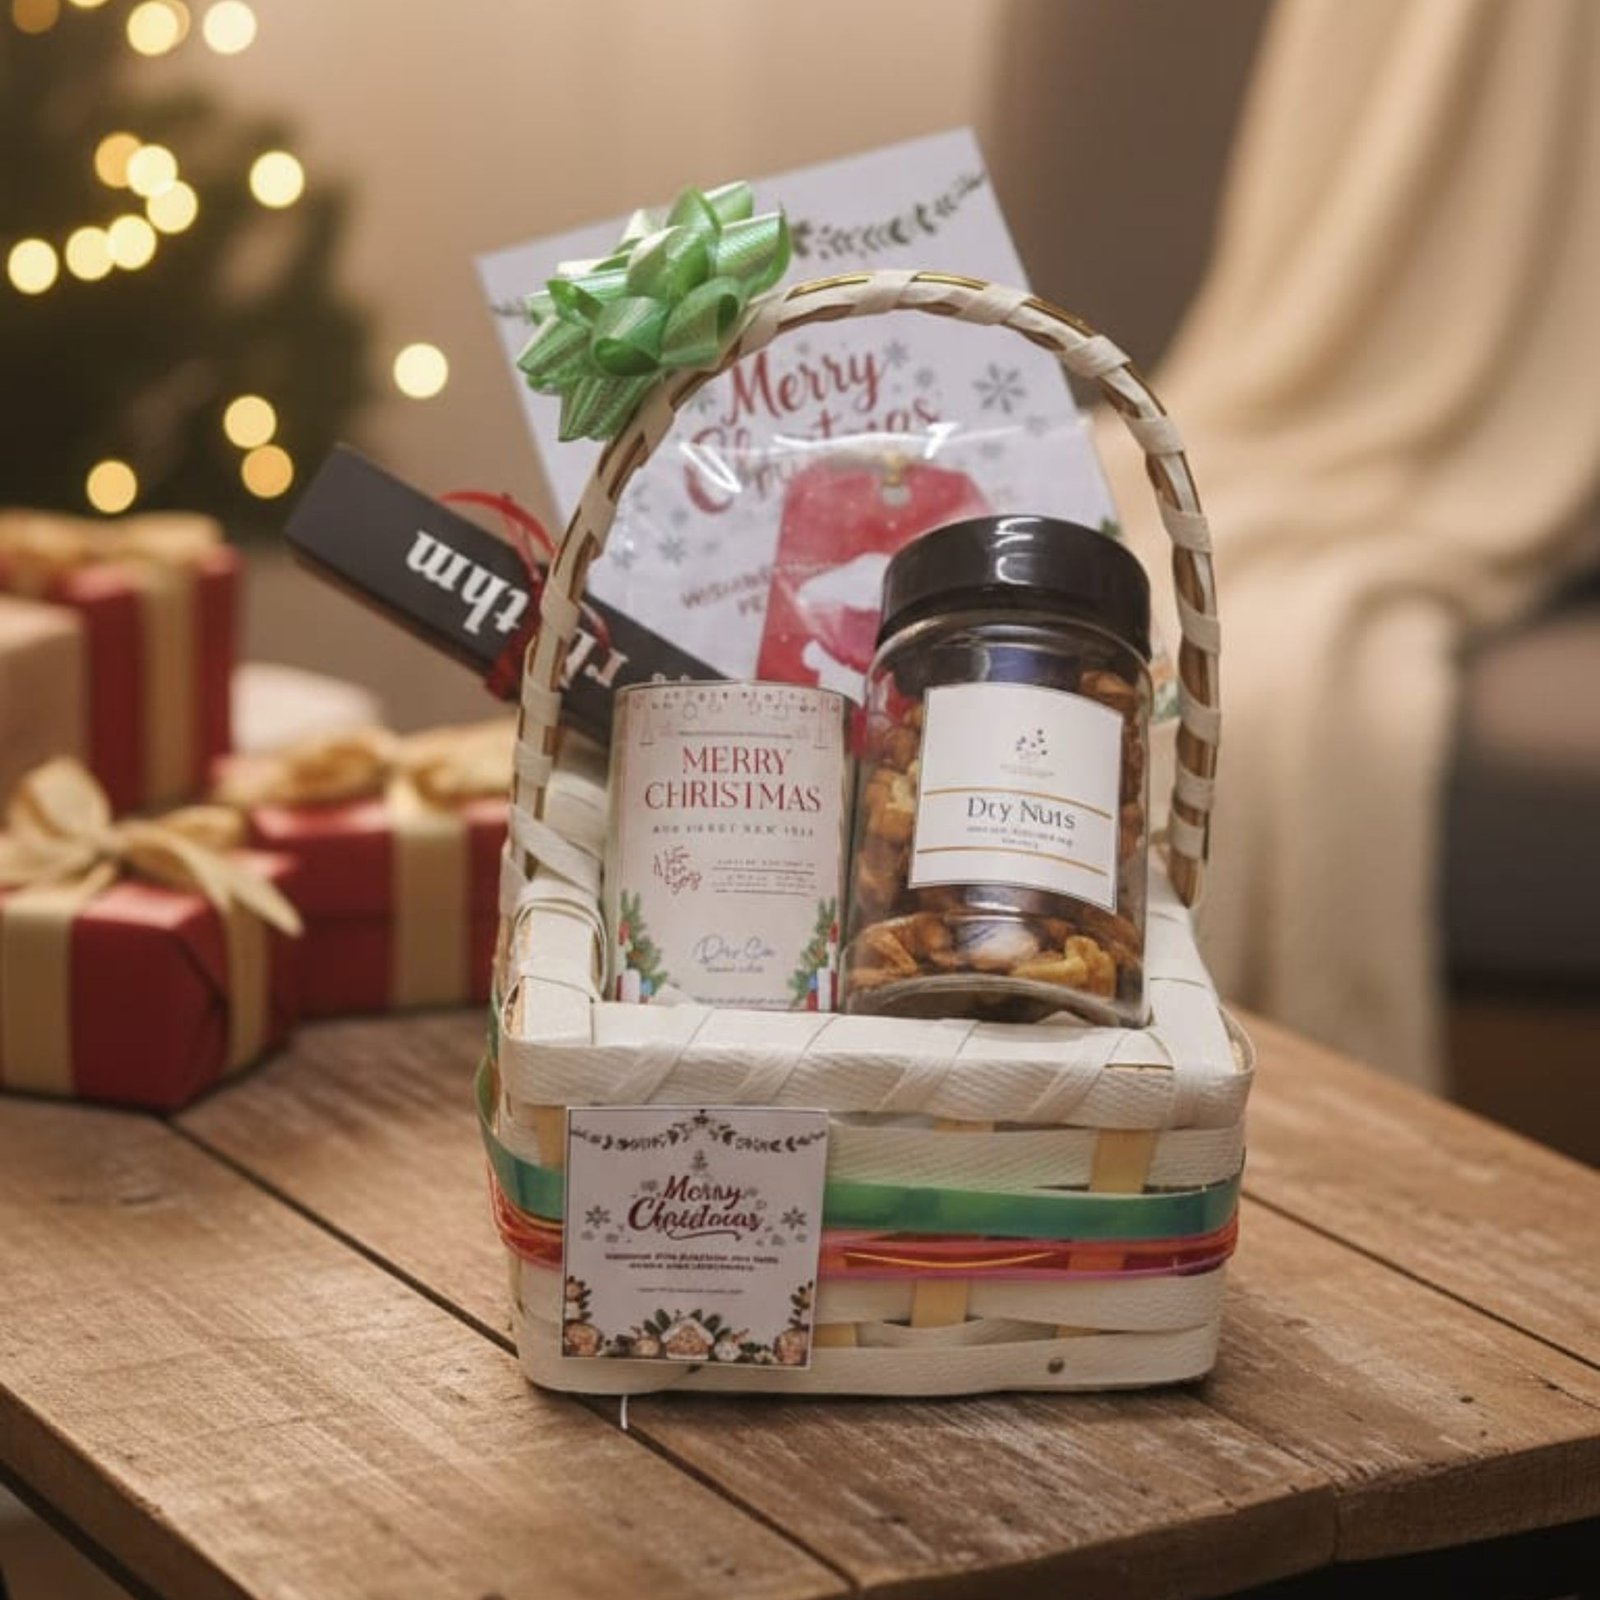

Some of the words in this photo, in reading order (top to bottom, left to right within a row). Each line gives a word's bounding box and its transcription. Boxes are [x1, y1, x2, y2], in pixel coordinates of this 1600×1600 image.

[721, 351, 881, 426] Merry
[406, 530, 628, 688] rhthm
[682, 746, 791, 775] MERRY
[644, 780, 822, 812] CHRISTMAS
[967, 796, 1012, 824] Dry
